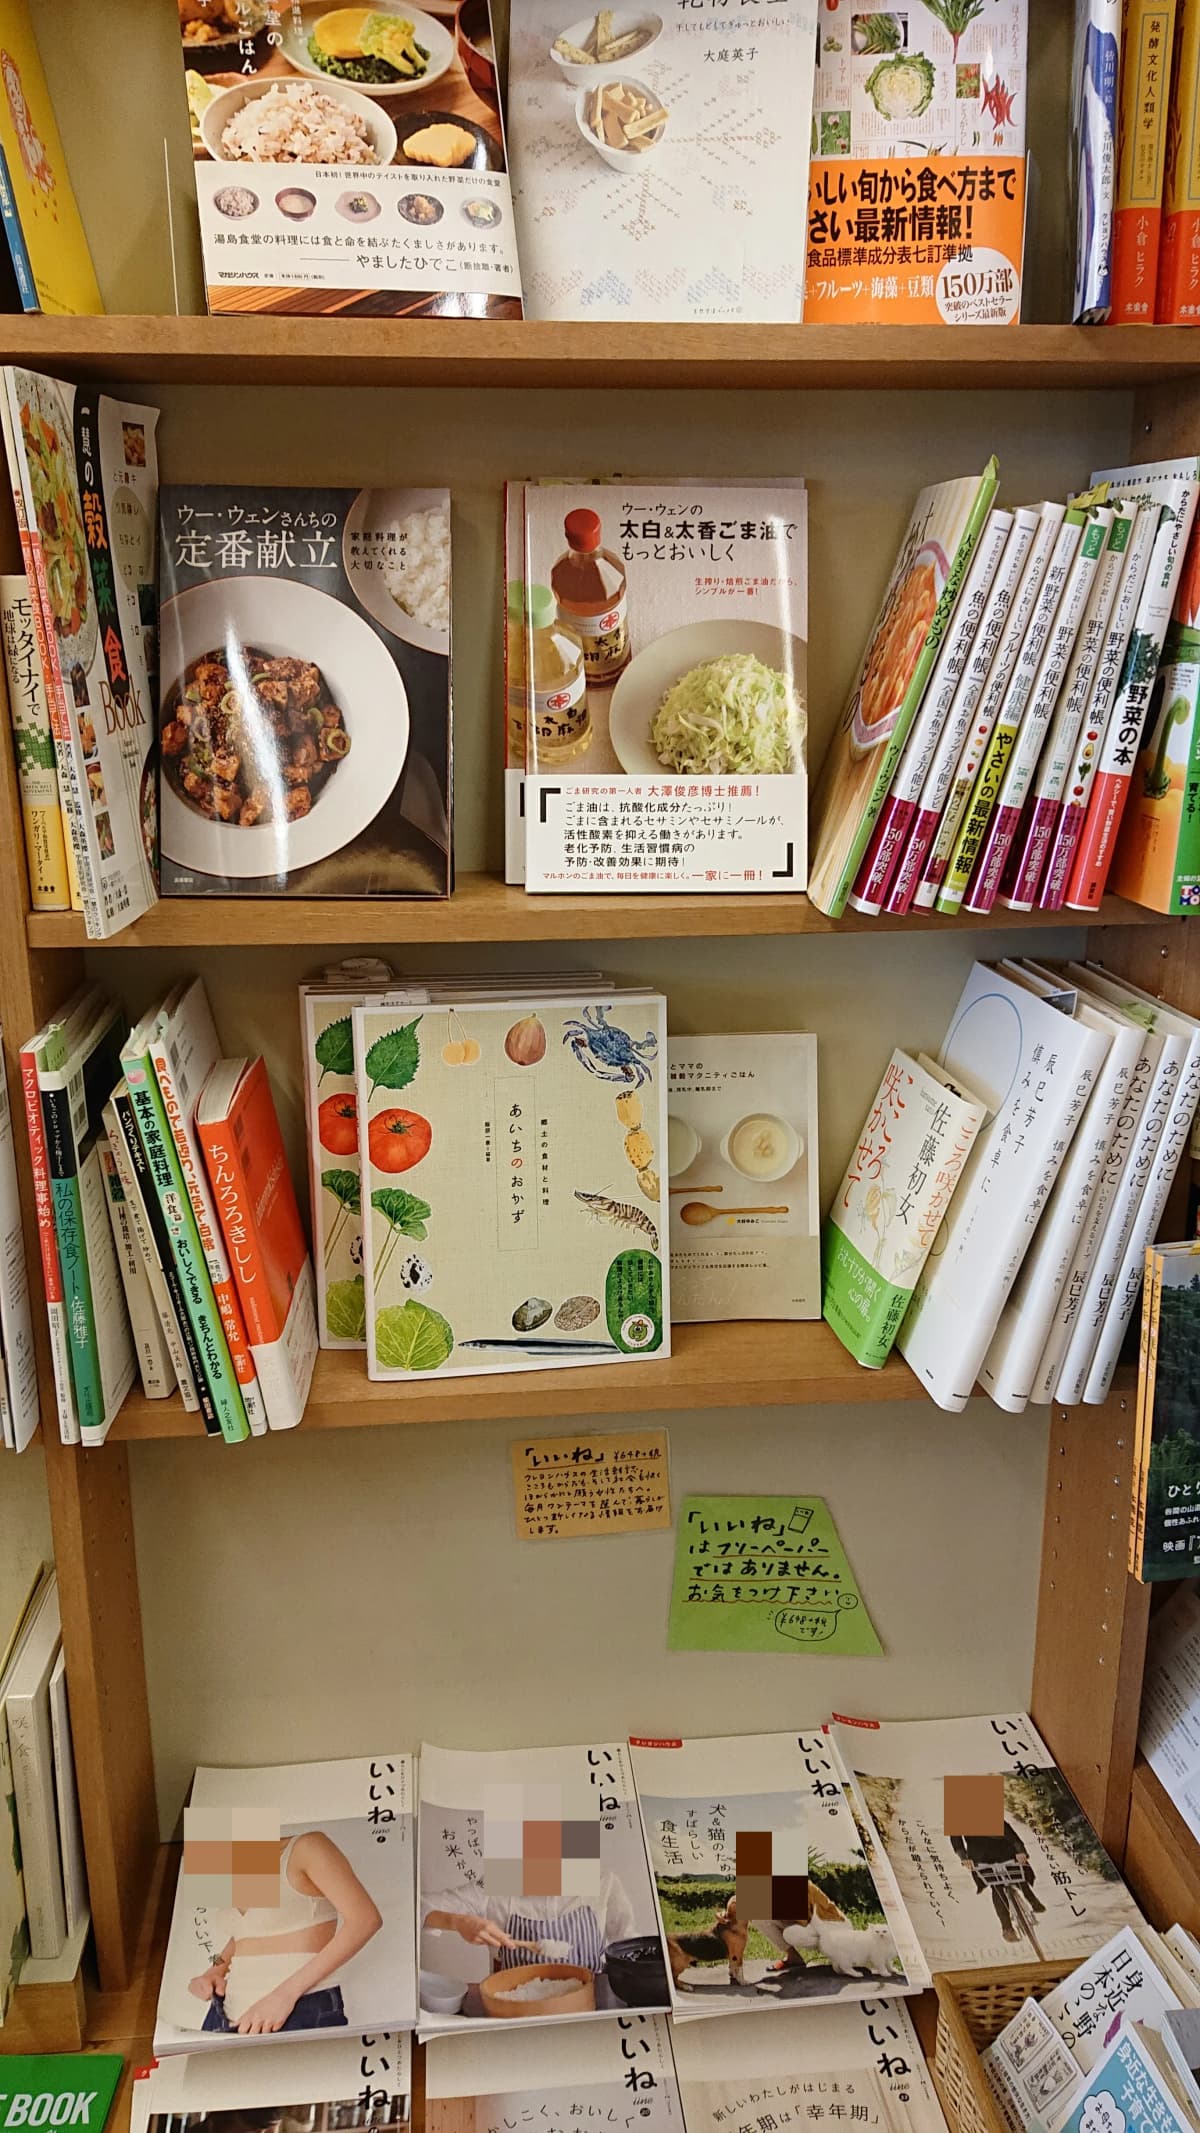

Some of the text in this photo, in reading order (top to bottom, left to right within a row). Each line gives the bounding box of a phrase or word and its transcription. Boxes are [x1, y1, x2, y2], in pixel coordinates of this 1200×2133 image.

[703, 47, 759, 63] 大庭英子
[1142, 20, 1161, 130] 発酵文化人類学
[214, 233, 504, 255] 湯島食堂の料理には食と命を結ぶたくましさがあります。
[808, 204, 973, 243] さい最新情報！
[356, 254, 457, 271] やましたひでこ
[807, 243, 973, 269] 食品標準成分表七訂準拠
[1134, 215, 1149, 288] 小倉ヒラク
[942, 268, 1013, 299] 150万部
[944, 296, 1013, 312] 突破のベストセラー
[954, 309, 1007, 322] シリーズ最新版
[177, 504, 337, 528] ウー・ウェンさんちの
[350, 531, 408, 541] 家庭料理が
[622, 502, 703, 517] ウー・ウェンの
[1112, 521, 1126, 551] もっと
[175, 529, 338, 569] 定番献立
[350, 546, 407, 556] 教えてくれる
[350, 560, 407, 571] 大切なこと
[622, 543, 735, 562] もっとおいしく
[1086, 526, 1104, 557] もっと
[694, 577, 799, 586] 生搾り・焙煎ごま油だら、
[695, 587, 758, 596] シンプルが一番！
[12, 598, 41, 716] モッタイナイで
[946, 589, 986, 676] 魚の便利帳
[972, 589, 1011, 676] 魚の便利帳
[1033, 625, 1075, 719] 野菜の便利帳
[1066, 619, 1104, 713] 野菜の便利帳
[1089, 631, 1126, 726] 野菜の便利帳
[98, 672, 146, 736] Book
[1113, 684, 1149, 767] 野菜の本
[565, 785, 760, 797] ごま研究の第一人者 大澤俊彦博士推薦！
[565, 801, 732, 813] ごま油は、抗酸化成分たっぷり！
[955, 732, 1013, 874] やさいの最新情報
[31, 810, 43, 874] ワンガリ・マータイ
[563, 829, 743, 840] 活性酸素を抑える働きがあります。
[563, 842, 695, 854] 老化予防、生活習慣病の
[565, 815, 785, 827] ごまに含まれるセサミンやセサミノールが、
[564, 856, 686, 868] 予防・改善効果に期待！
[691, 870, 764, 881] 一家に一冊！
[980, 1043, 1044, 1193] 慎みを食卓に
[1014, 1053, 1058, 1154] 辰巳芳子
[1100, 1056, 1151, 1186] あなたのために
[1129, 1060, 1179, 1188] あなたのために
[1156, 1055, 1200, 1182] あなたのために
[22, 1068, 51, 1228] マクロビオティック料理事始め
[133, 1090, 175, 1188] 基本の家庭料理
[509, 1103, 525, 1224] あいちのおかず
[540, 1119, 550, 1206] 郷土の食材と料理
[895, 1101, 952, 1225] 佐藤初女
[1024, 1069, 1093, 1224] 辰巳芳子 慎みを食卓に
[1071, 1067, 1129, 1225] 辰巳芳子 慎みを食卓に
[918, 1116, 978, 1247] こころ咲かせて
[208, 1144, 257, 1284] ちんろろきしし
[55, 1183, 88, 1349] 私の保存食ノート 佐藤雅子
[176, 1238, 203, 1305] おいしくできる
[197, 1314, 223, 1380] きちんとわかる
[1062, 1270, 1087, 1324] 辰巳芳子
[1092, 1273, 1115, 1327] 辰巳芳子
[1119, 1266, 1144, 1321] 辰巳芳子
[876, 1293, 906, 1349] 佐藤初女
[525, 1446, 605, 1468] 「いいね」
[529, 1524, 559, 1535] します。
[687, 1511, 785, 1537] 「いいね」
[688, 1537, 829, 1556] はフリーペーパー
[687, 1583, 840, 1602] お気をつけ下さい
[693, 1558, 840, 1579] ではありません。
[797, 1737, 841, 1798] いいね
[990, 1720, 1042, 1779] いいね
[367, 1762, 396, 1824] いいね
[466, 1816, 484, 1858] やっぱり
[659, 1819, 684, 1865] 食生活
[686, 1809, 704, 1861] すばらしい
[706, 1803, 737, 1882] 犬&猫のための
[1051, 1871, 1086, 1917] 筋トレ
[618, 2016, 657, 2092] いいね
[860, 1999, 911, 2078] いいね
[357, 2032, 391, 2110] いいね
[4, 2091, 98, 2127] BOOK
[712, 2081, 856, 2122] 新しいわたしがはじまる
